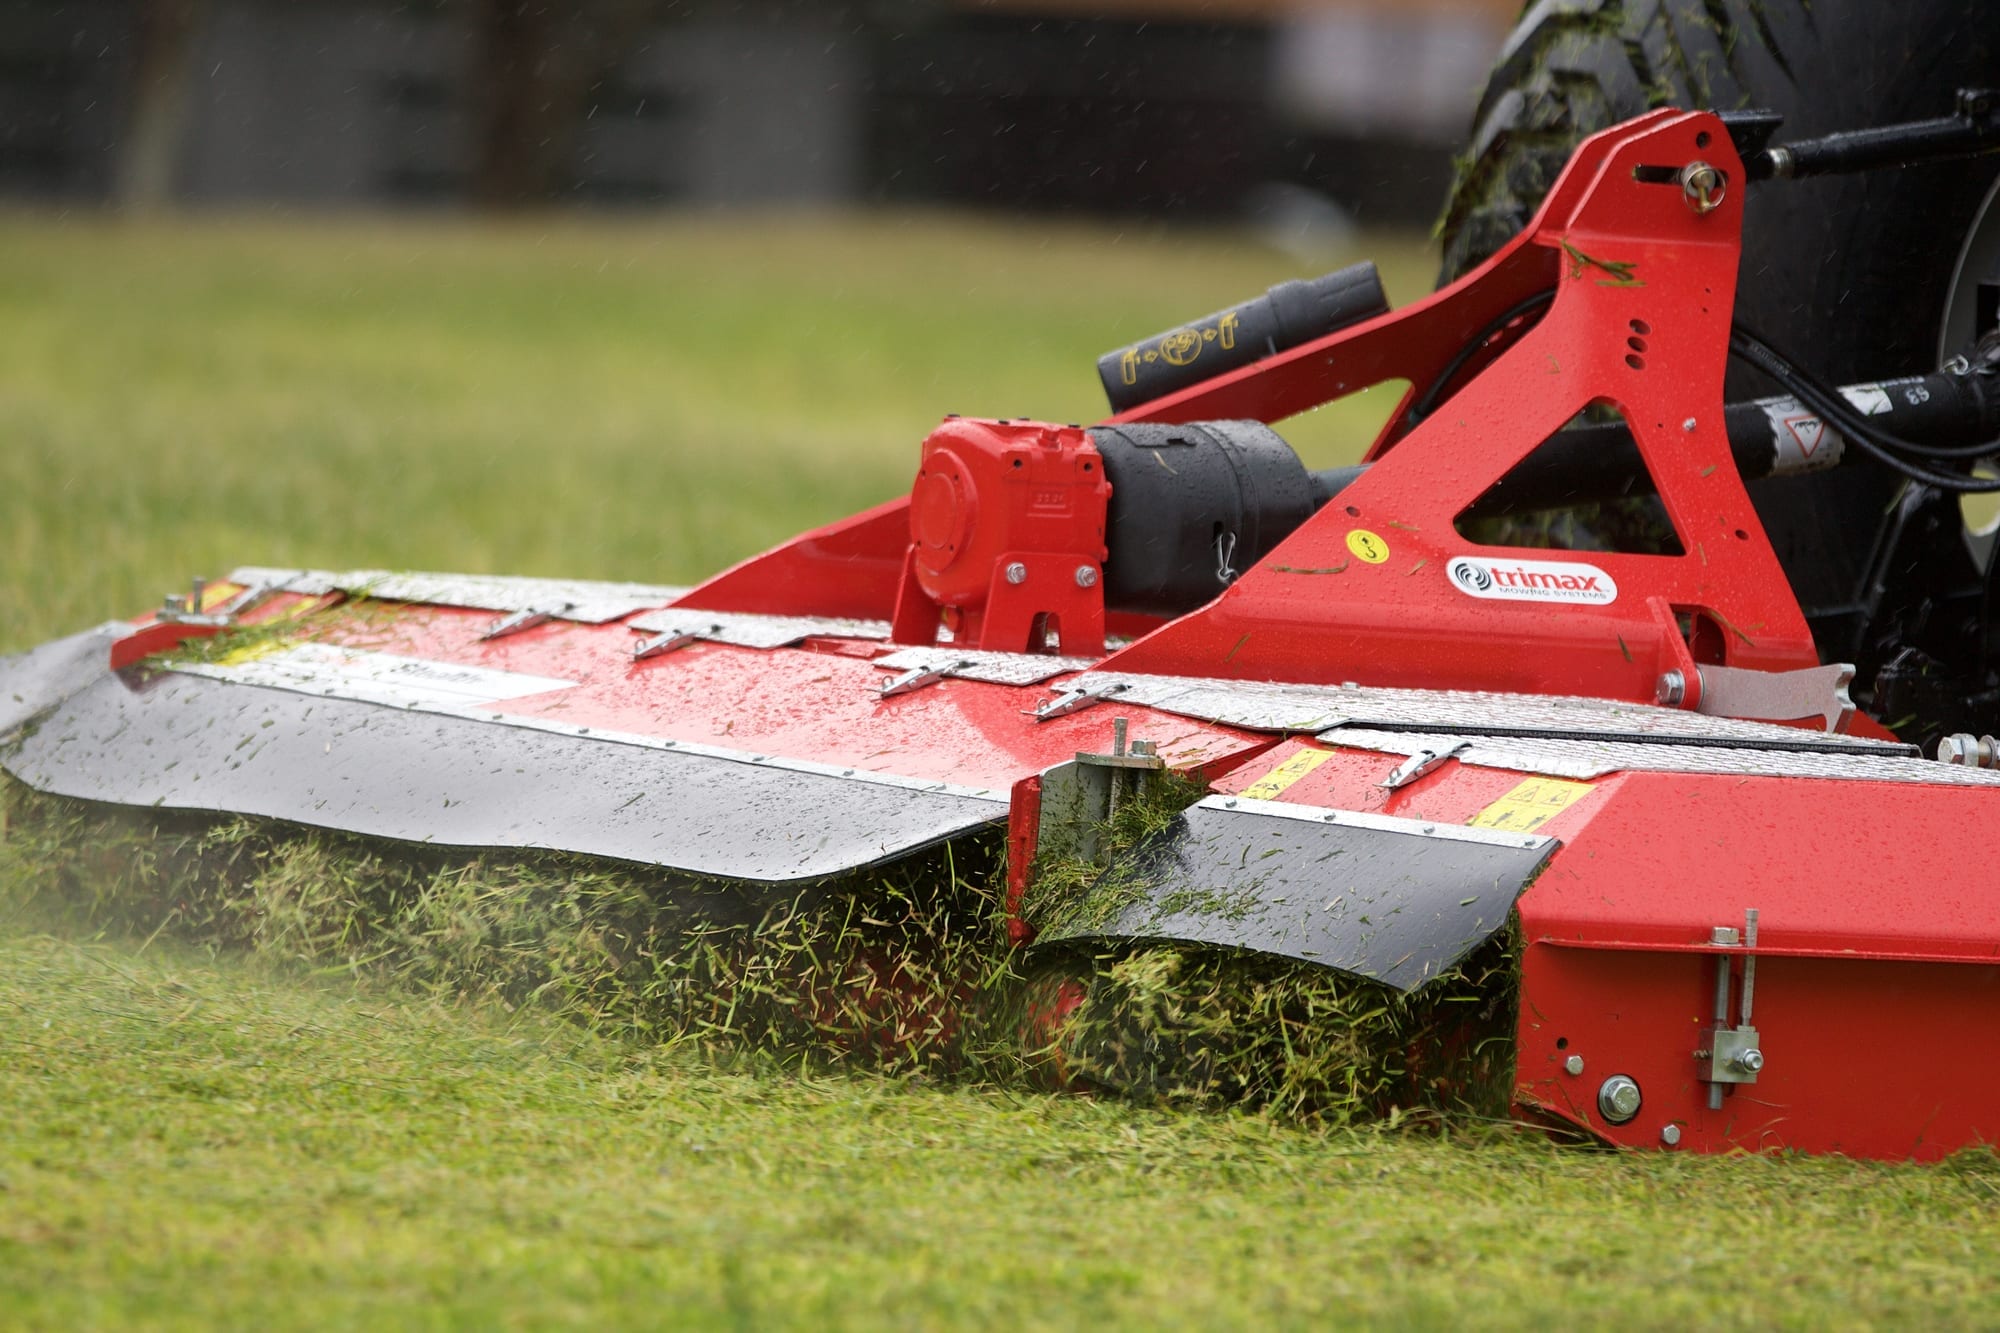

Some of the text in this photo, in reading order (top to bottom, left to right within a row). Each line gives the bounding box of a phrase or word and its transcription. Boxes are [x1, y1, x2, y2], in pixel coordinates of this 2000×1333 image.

[1491, 567, 1602, 592] trimax
[1499, 587, 1607, 599] MOWING SYSTEMS
